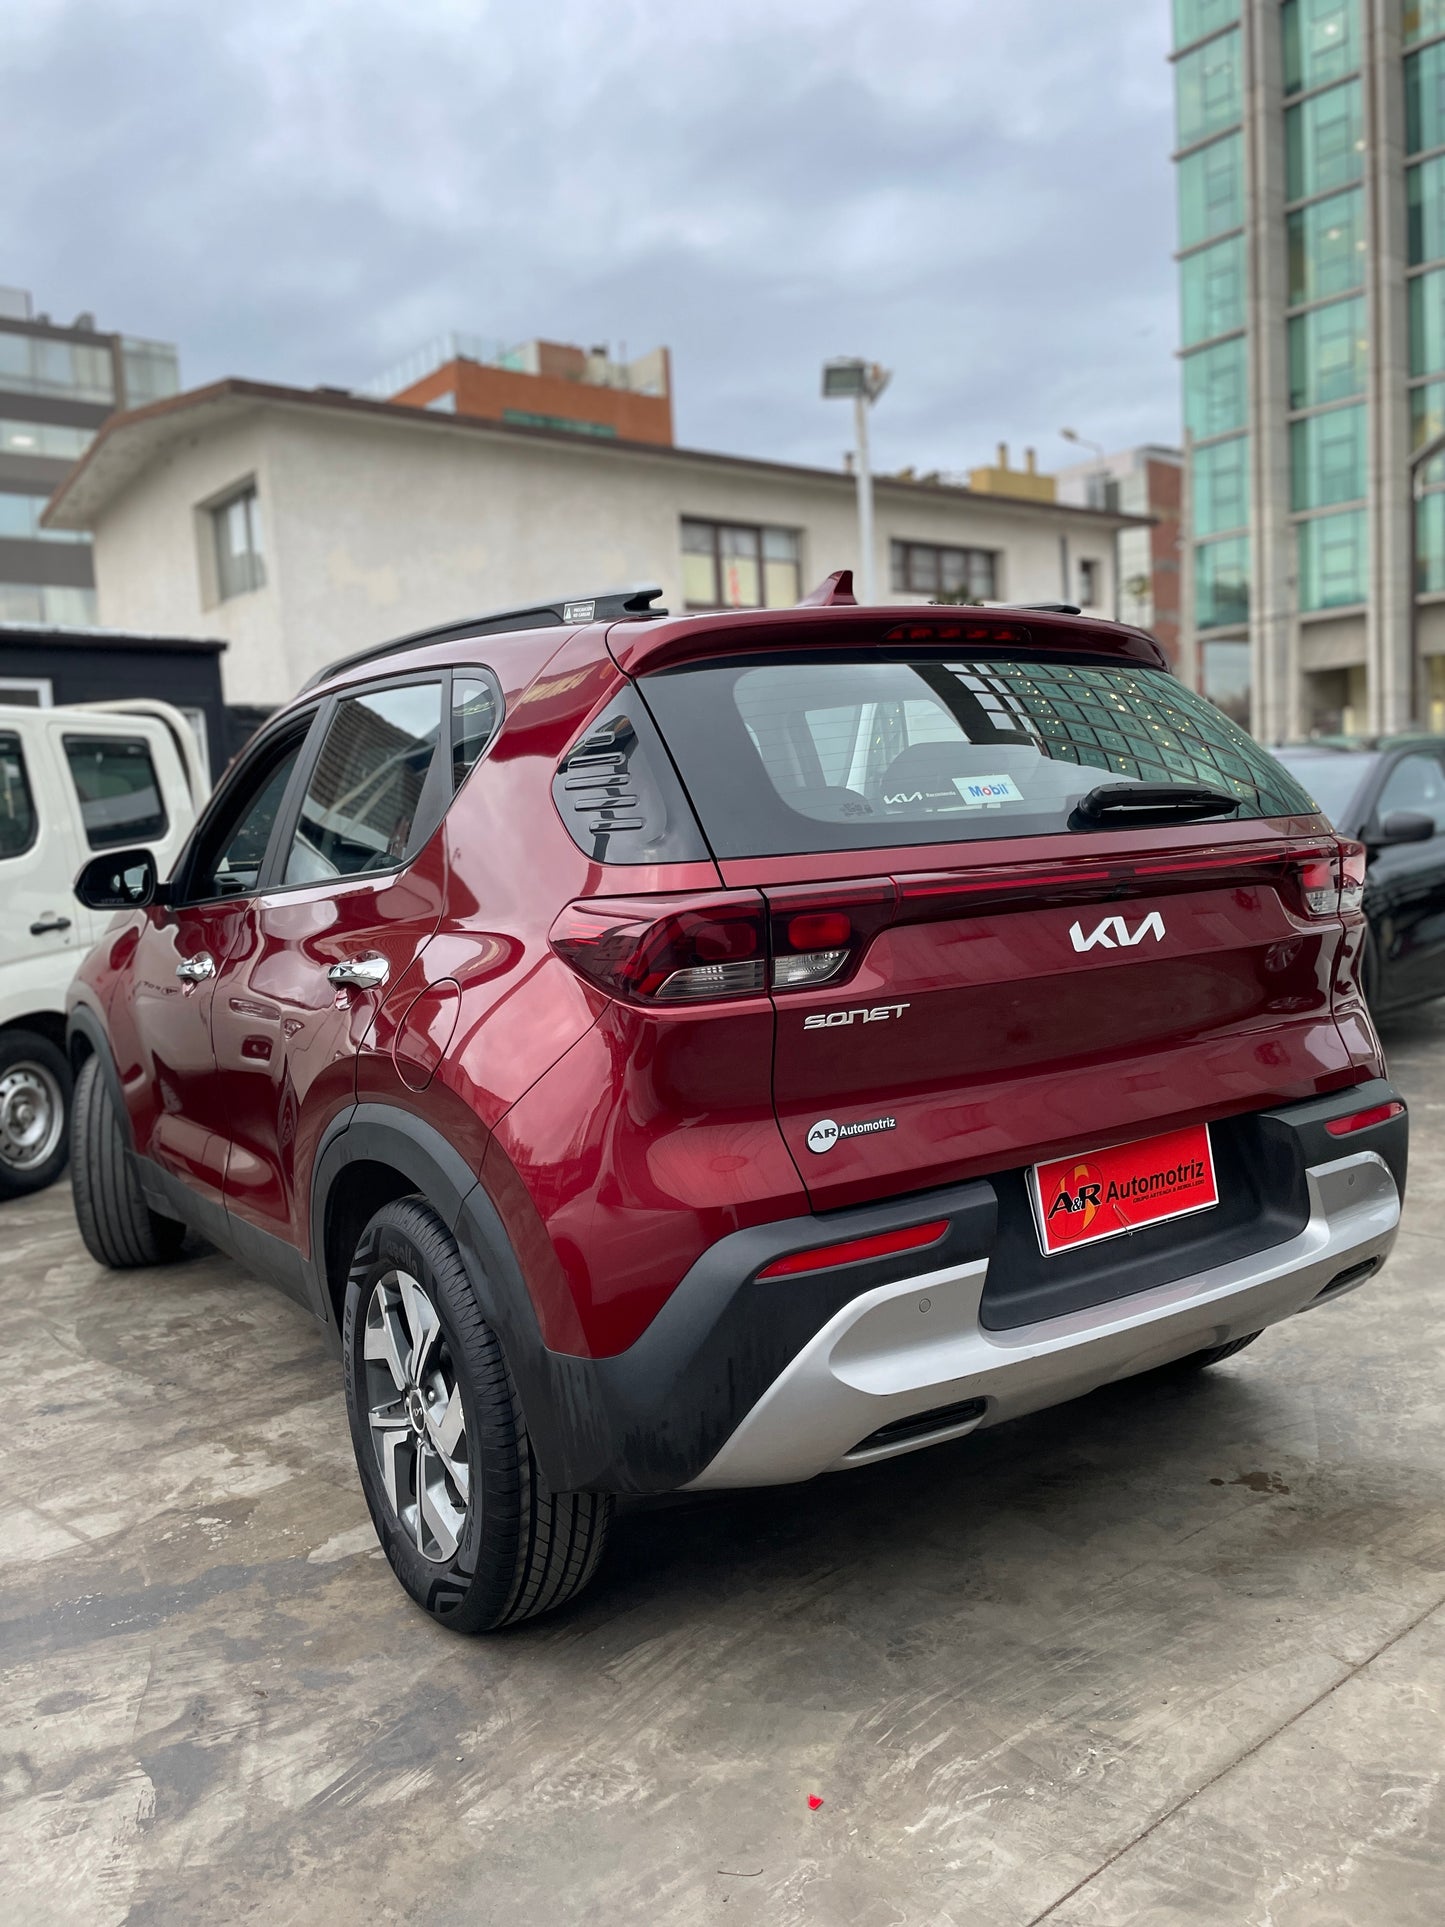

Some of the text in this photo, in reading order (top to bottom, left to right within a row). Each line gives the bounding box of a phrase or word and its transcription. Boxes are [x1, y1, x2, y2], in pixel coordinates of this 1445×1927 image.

[884, 791, 923, 804] KIA
[968, 784, 1008, 797] Mobil
[1069, 911, 1166, 953] KIA
[803, 1003, 911, 1030] SONET
[839, 1117, 896, 1138] Automotriz
[1048, 1158, 1205, 1219] A&R Automotriz
